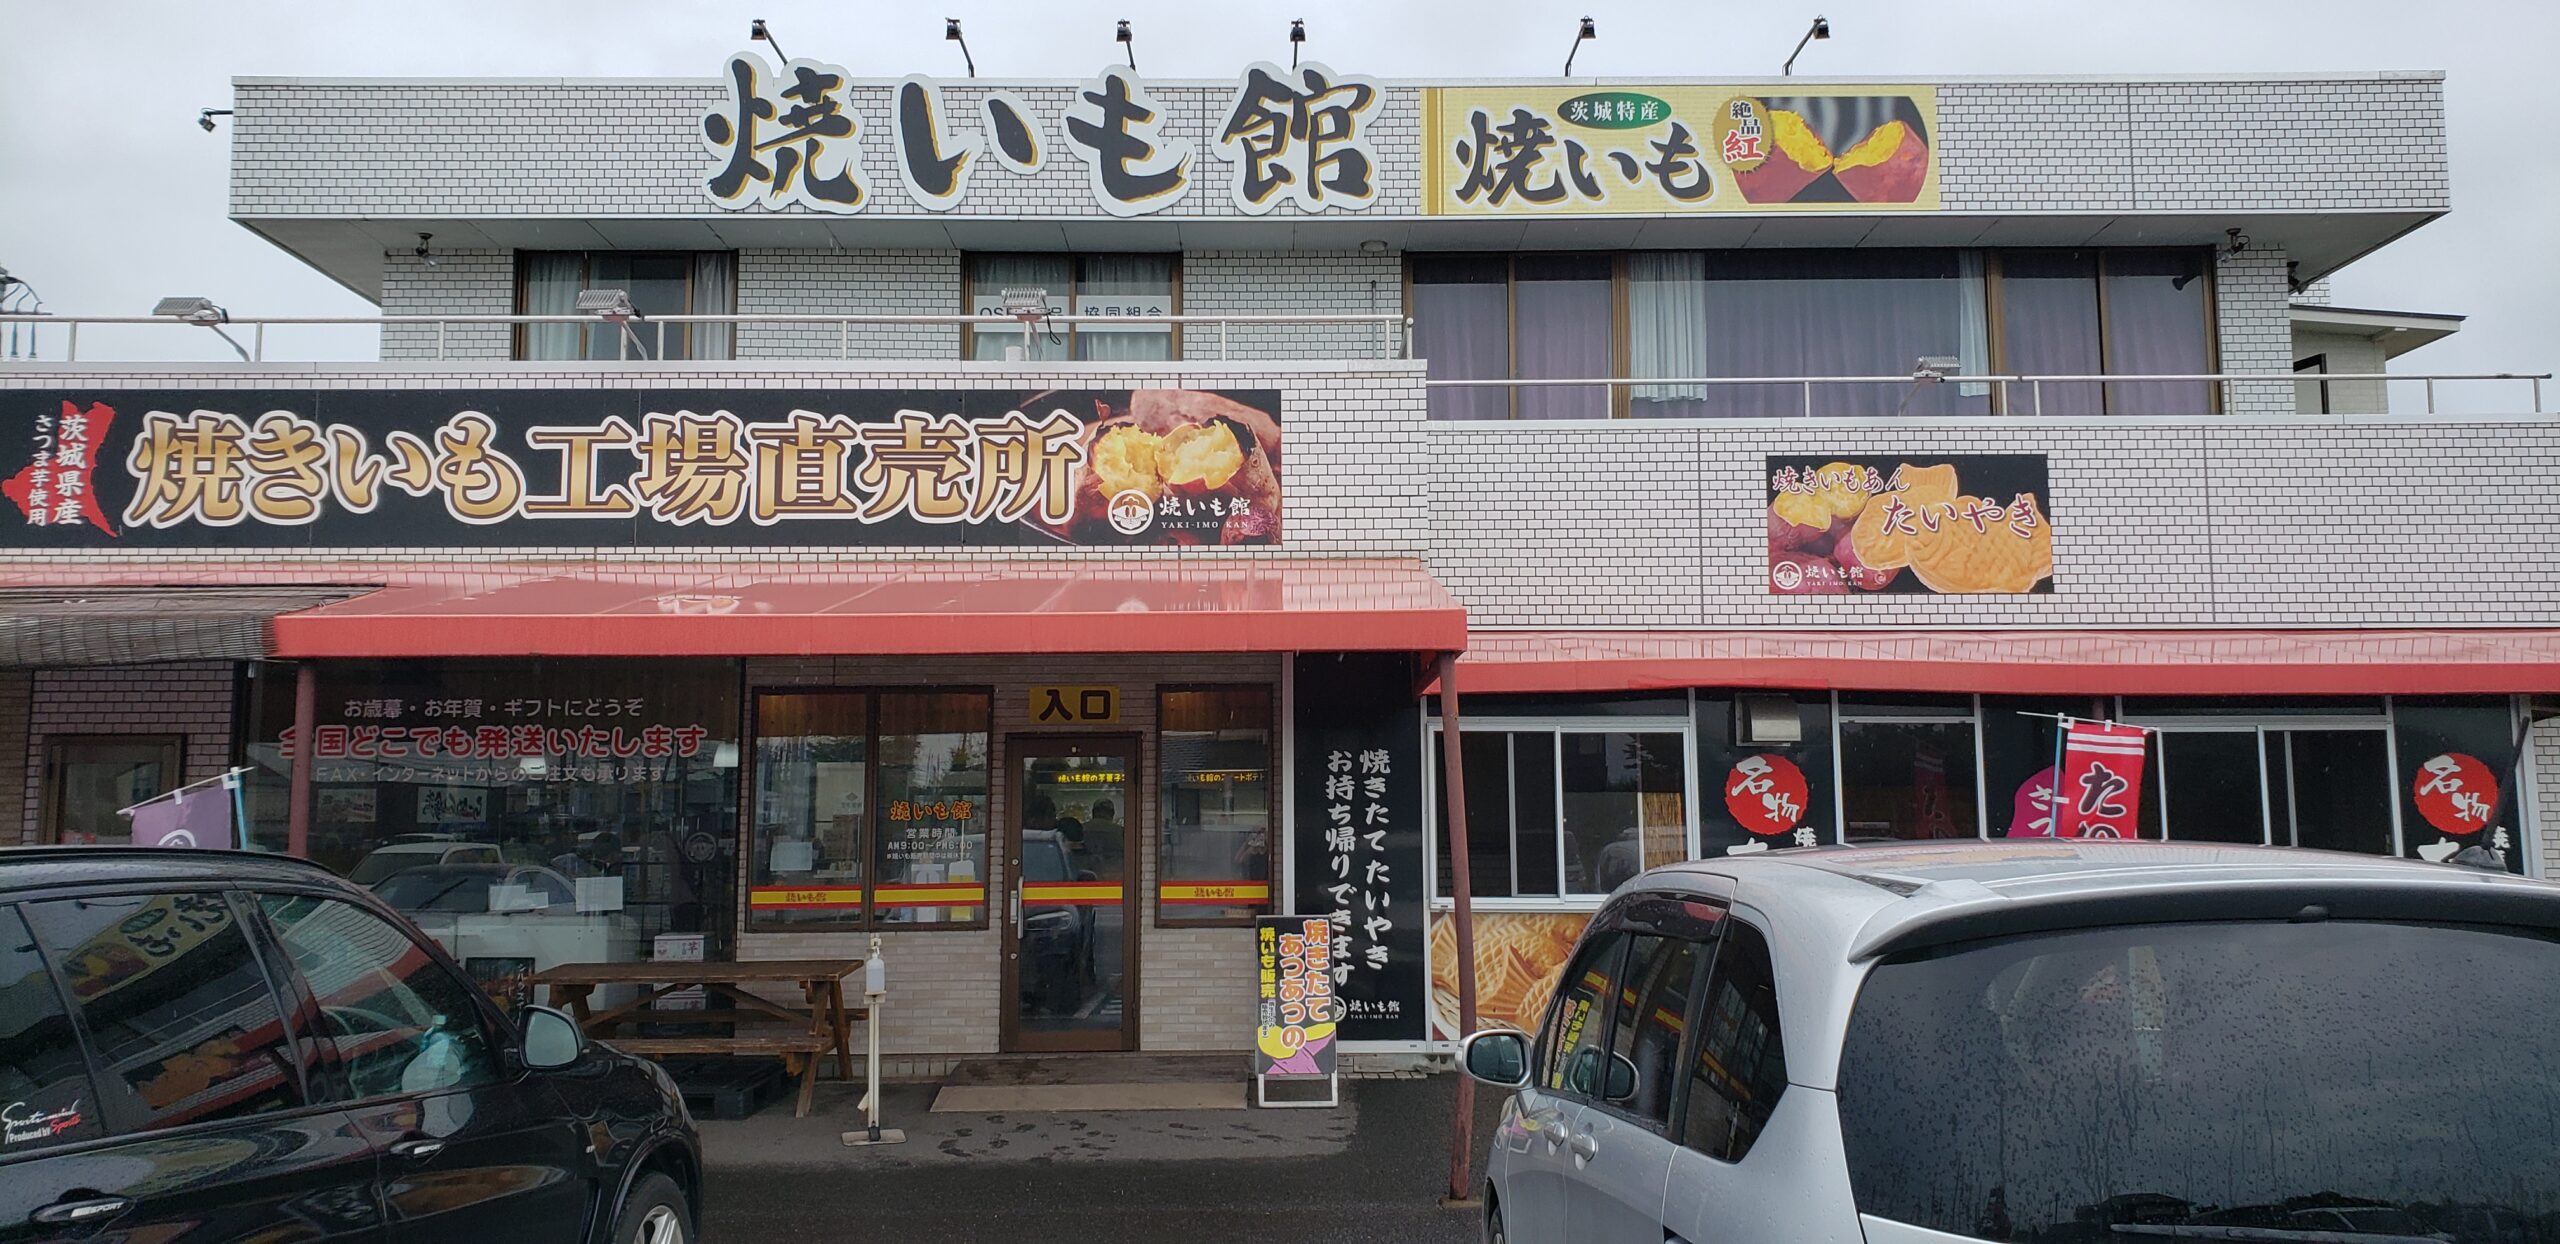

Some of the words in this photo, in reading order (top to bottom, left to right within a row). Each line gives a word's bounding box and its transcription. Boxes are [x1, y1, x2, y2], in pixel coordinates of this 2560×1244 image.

[1570, 100, 1660, 122] 茨城特産
[1731, 100, 1762, 135] 絶品
[704, 57, 1376, 206] 焼いも館
[1455, 109, 1713, 206] 焼いも
[1724, 137, 1761, 163] 紅
[26, 414, 52, 527] さつま芋使用
[53, 414, 88, 525] 茨城県産
[128, 412, 1080, 524] 焼きいも工場直売所
[1772, 466, 1910, 495] 焼きいもあん
[1159, 496, 1250, 516] 焼いも館
[1880, 492, 2038, 538] たいやき
[1226, 521, 1248, 529] KAN
[1805, 565, 1864, 579] 焼いも館
[1039, 689, 1110, 721] 入口
[1731, 756, 1800, 822] 名物
[2420, 755, 2491, 821] 名物
[890, 801, 973, 821] 焼いも館
[906, 827, 957, 839] 営業時間
[1260, 927, 1276, 998] 焼いも販売
[1303, 919, 1331, 1022] 焼きたて
[1279, 933, 1306, 1049] あつあつの
[1349, 999, 1400, 1012] 焼いも館
[9, 1127, 41, 1143] Produced
